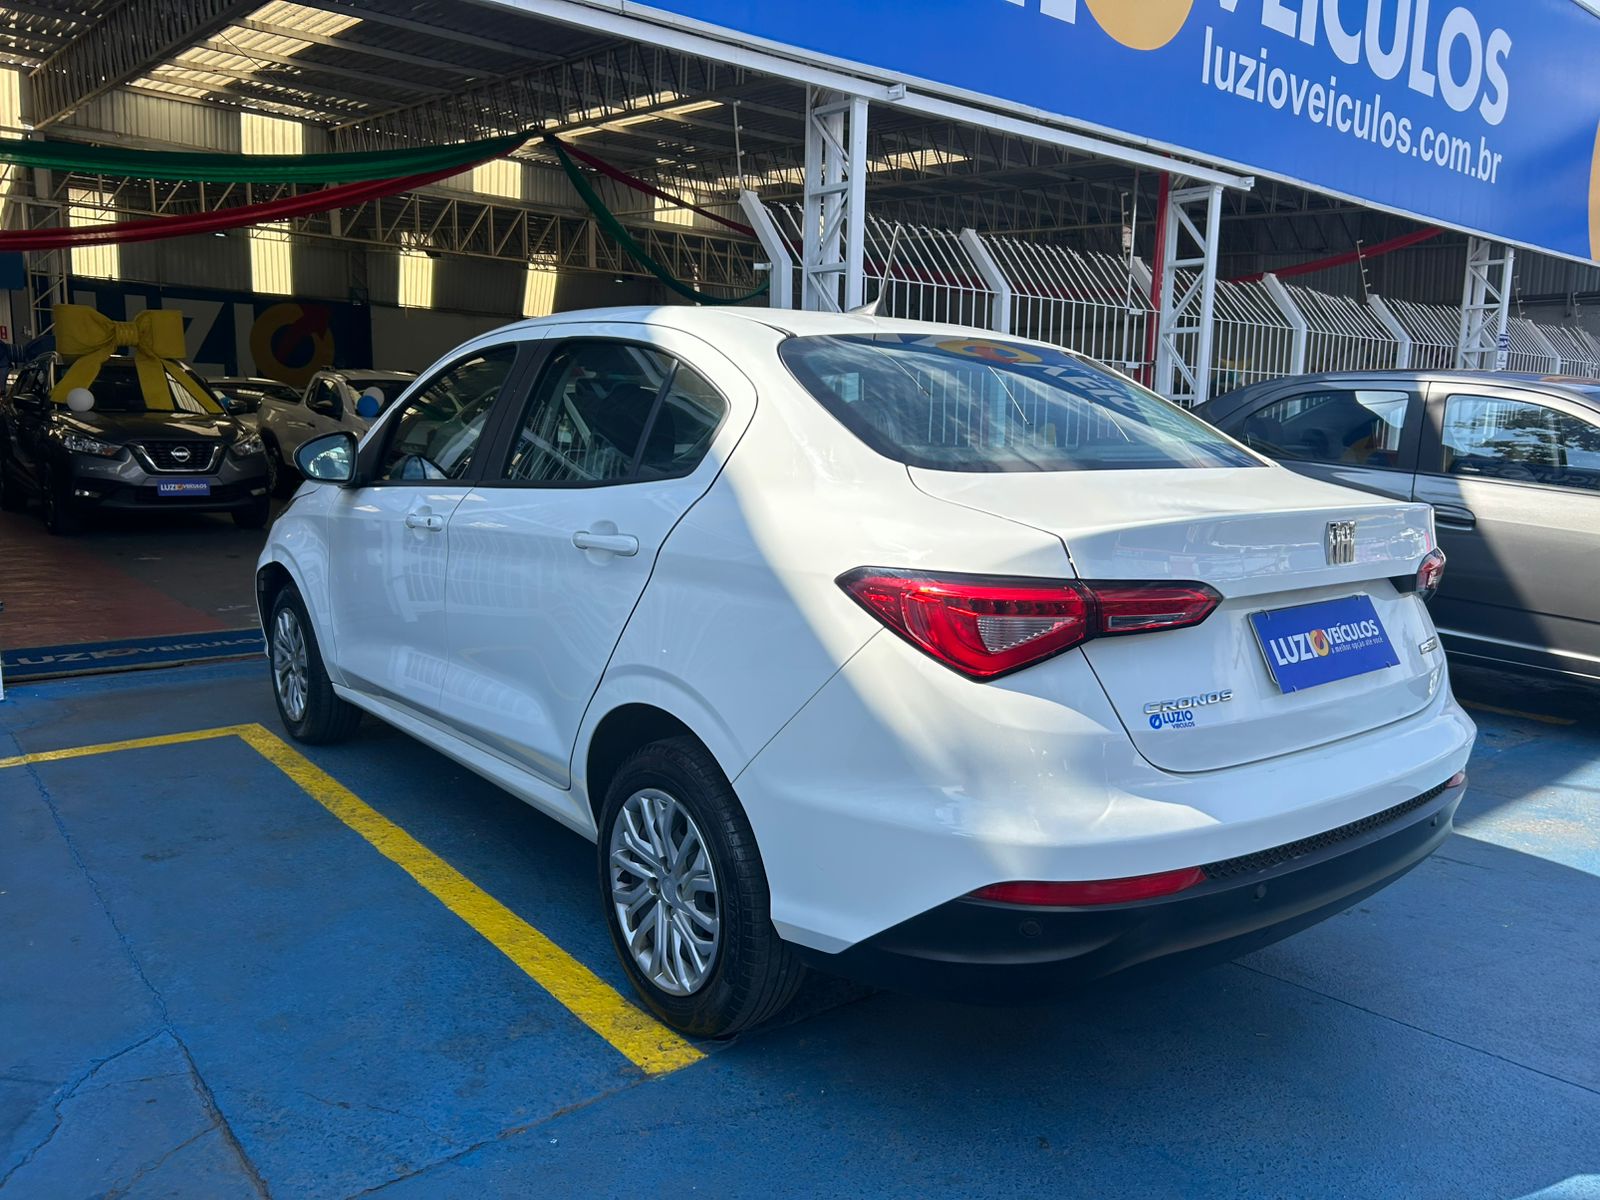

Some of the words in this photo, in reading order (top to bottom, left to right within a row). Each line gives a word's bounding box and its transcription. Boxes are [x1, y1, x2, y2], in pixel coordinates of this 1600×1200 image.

[1219, 0, 1512, 126] CULOS
[1202, 26, 1502, 184] luzioveiculos.com.br
[1270, 628, 1330, 666] LUZIO
[1321, 619, 1380, 645] VEÍCULOS
[1143, 689, 1233, 714] CRONOS
[1162, 710, 1193, 724] LUZIO
